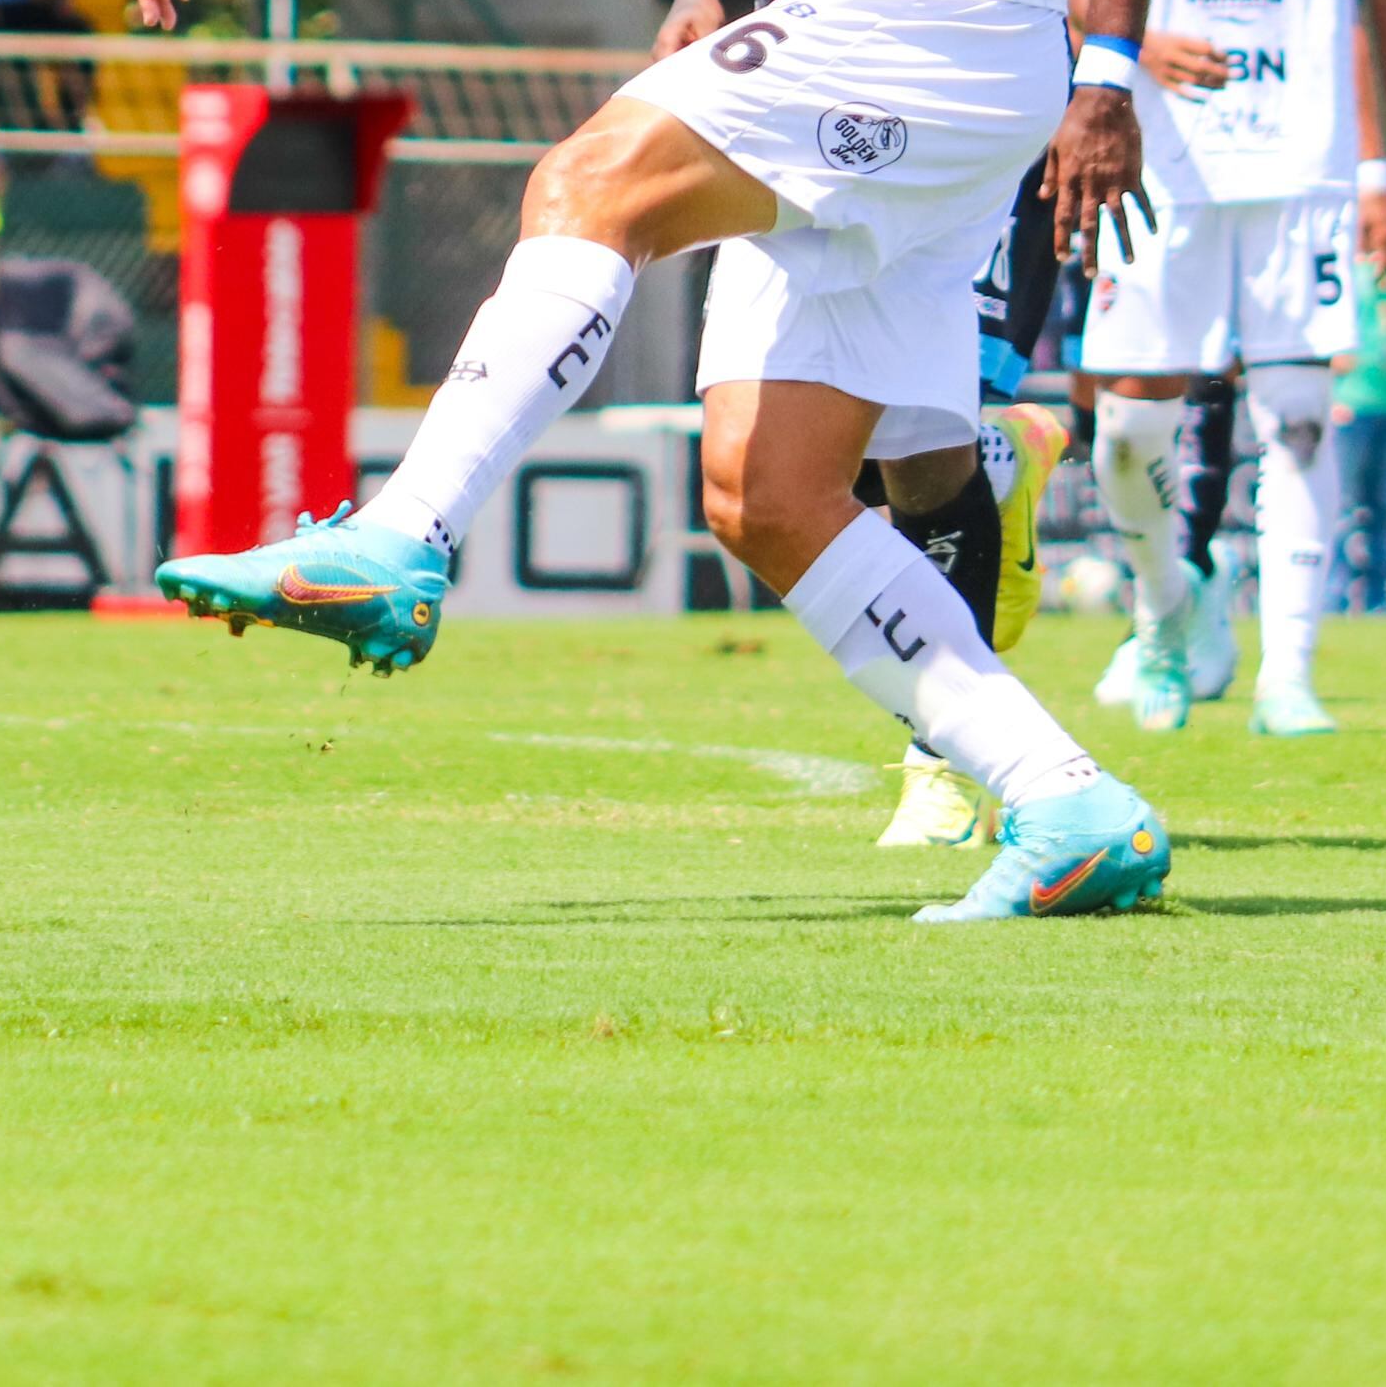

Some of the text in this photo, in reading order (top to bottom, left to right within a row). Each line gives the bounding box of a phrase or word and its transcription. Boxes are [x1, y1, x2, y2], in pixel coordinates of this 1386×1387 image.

[709, 21, 790, 75] 6
[835, 118, 879, 163] GOLDEN
[1315, 252, 1343, 306] 5
